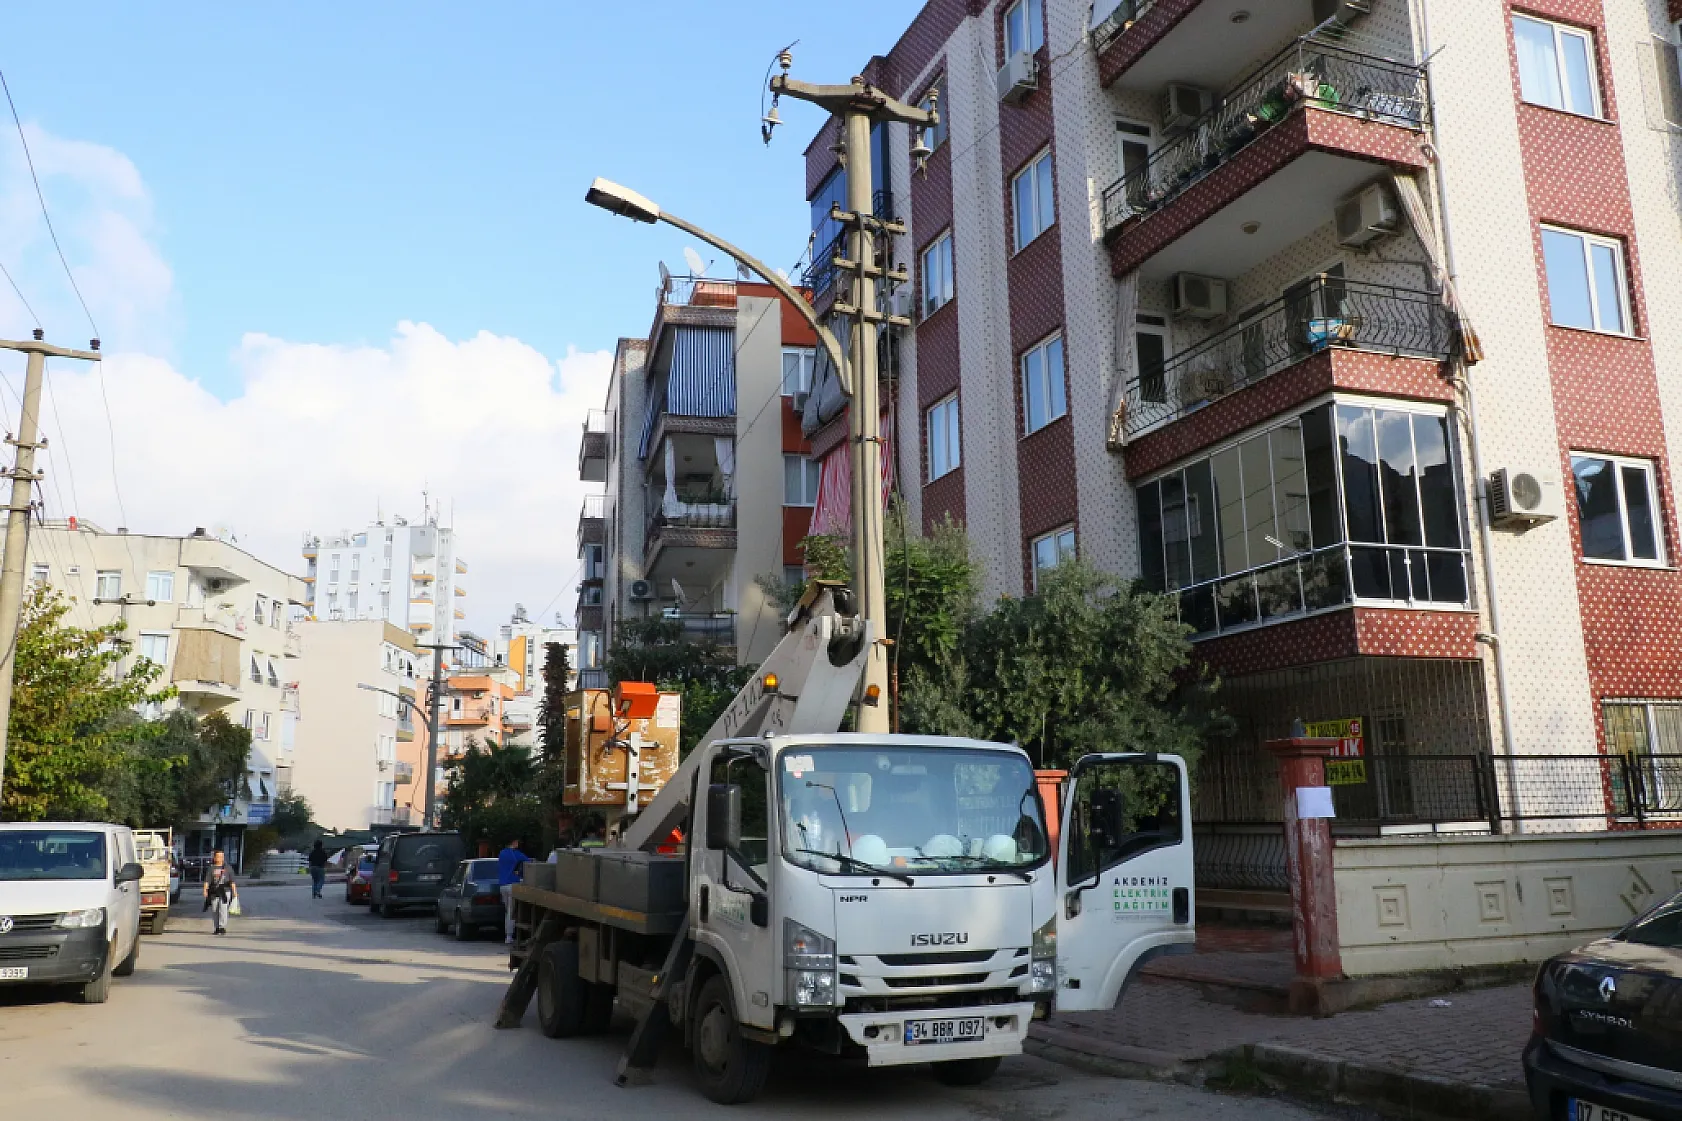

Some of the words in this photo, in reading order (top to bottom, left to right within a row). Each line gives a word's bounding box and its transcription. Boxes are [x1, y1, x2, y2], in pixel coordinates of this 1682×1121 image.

[839, 895, 868, 903] NPR
[910, 932, 969, 947] ISUZU
[1580, 1009, 1637, 1031] SYMBOL
[913, 1022, 928, 1039] 34
[959, 1019, 980, 1035] 097
